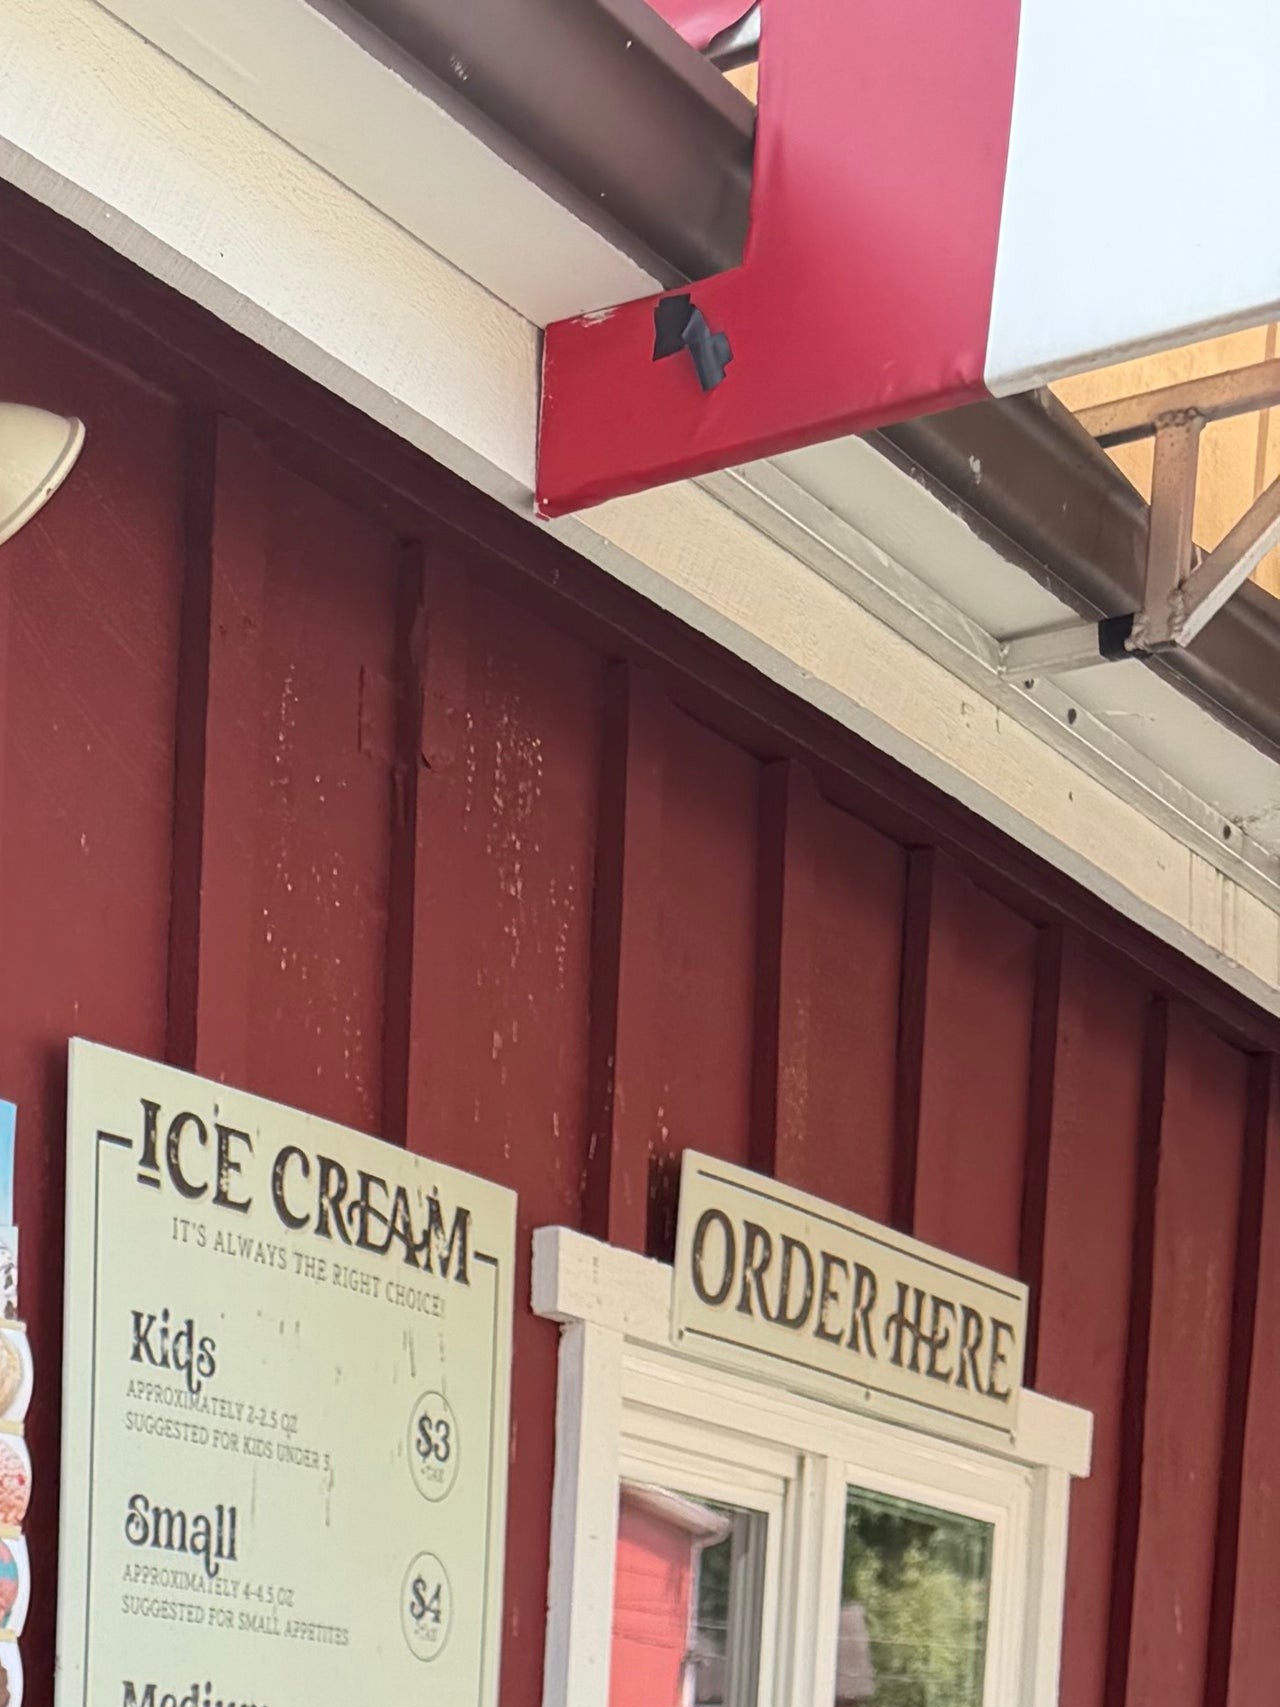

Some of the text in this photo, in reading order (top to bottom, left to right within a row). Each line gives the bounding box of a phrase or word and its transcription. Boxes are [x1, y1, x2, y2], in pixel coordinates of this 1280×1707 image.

[138, 1098, 470, 1285] ICE CREAM
[172, 1217, 446, 1318] IT'S ALWAYS THE RIGHT CHOICE!
[691, 1208, 1016, 1400] ORDER HERE
[130, 1308, 216, 1393] Kids
[126, 1379, 298, 1433] APPROXIMATELY 2-2.5 OZ
[125, 1412, 208, 1445] SUGGESTED
[213, 1429, 238, 1449] FOR
[243, 1435, 273, 1459] KIDS
[277, 1443, 318, 1469] UNDER
[416, 1411, 450, 1463] $3
[125, 1494, 238, 1578] Small
[123, 1564, 239, 1599] APPROXIMATELY
[410, 1574, 442, 1623] $4
[122, 1595, 349, 1646] SUGGESTED FOR SMALL APPETITES
